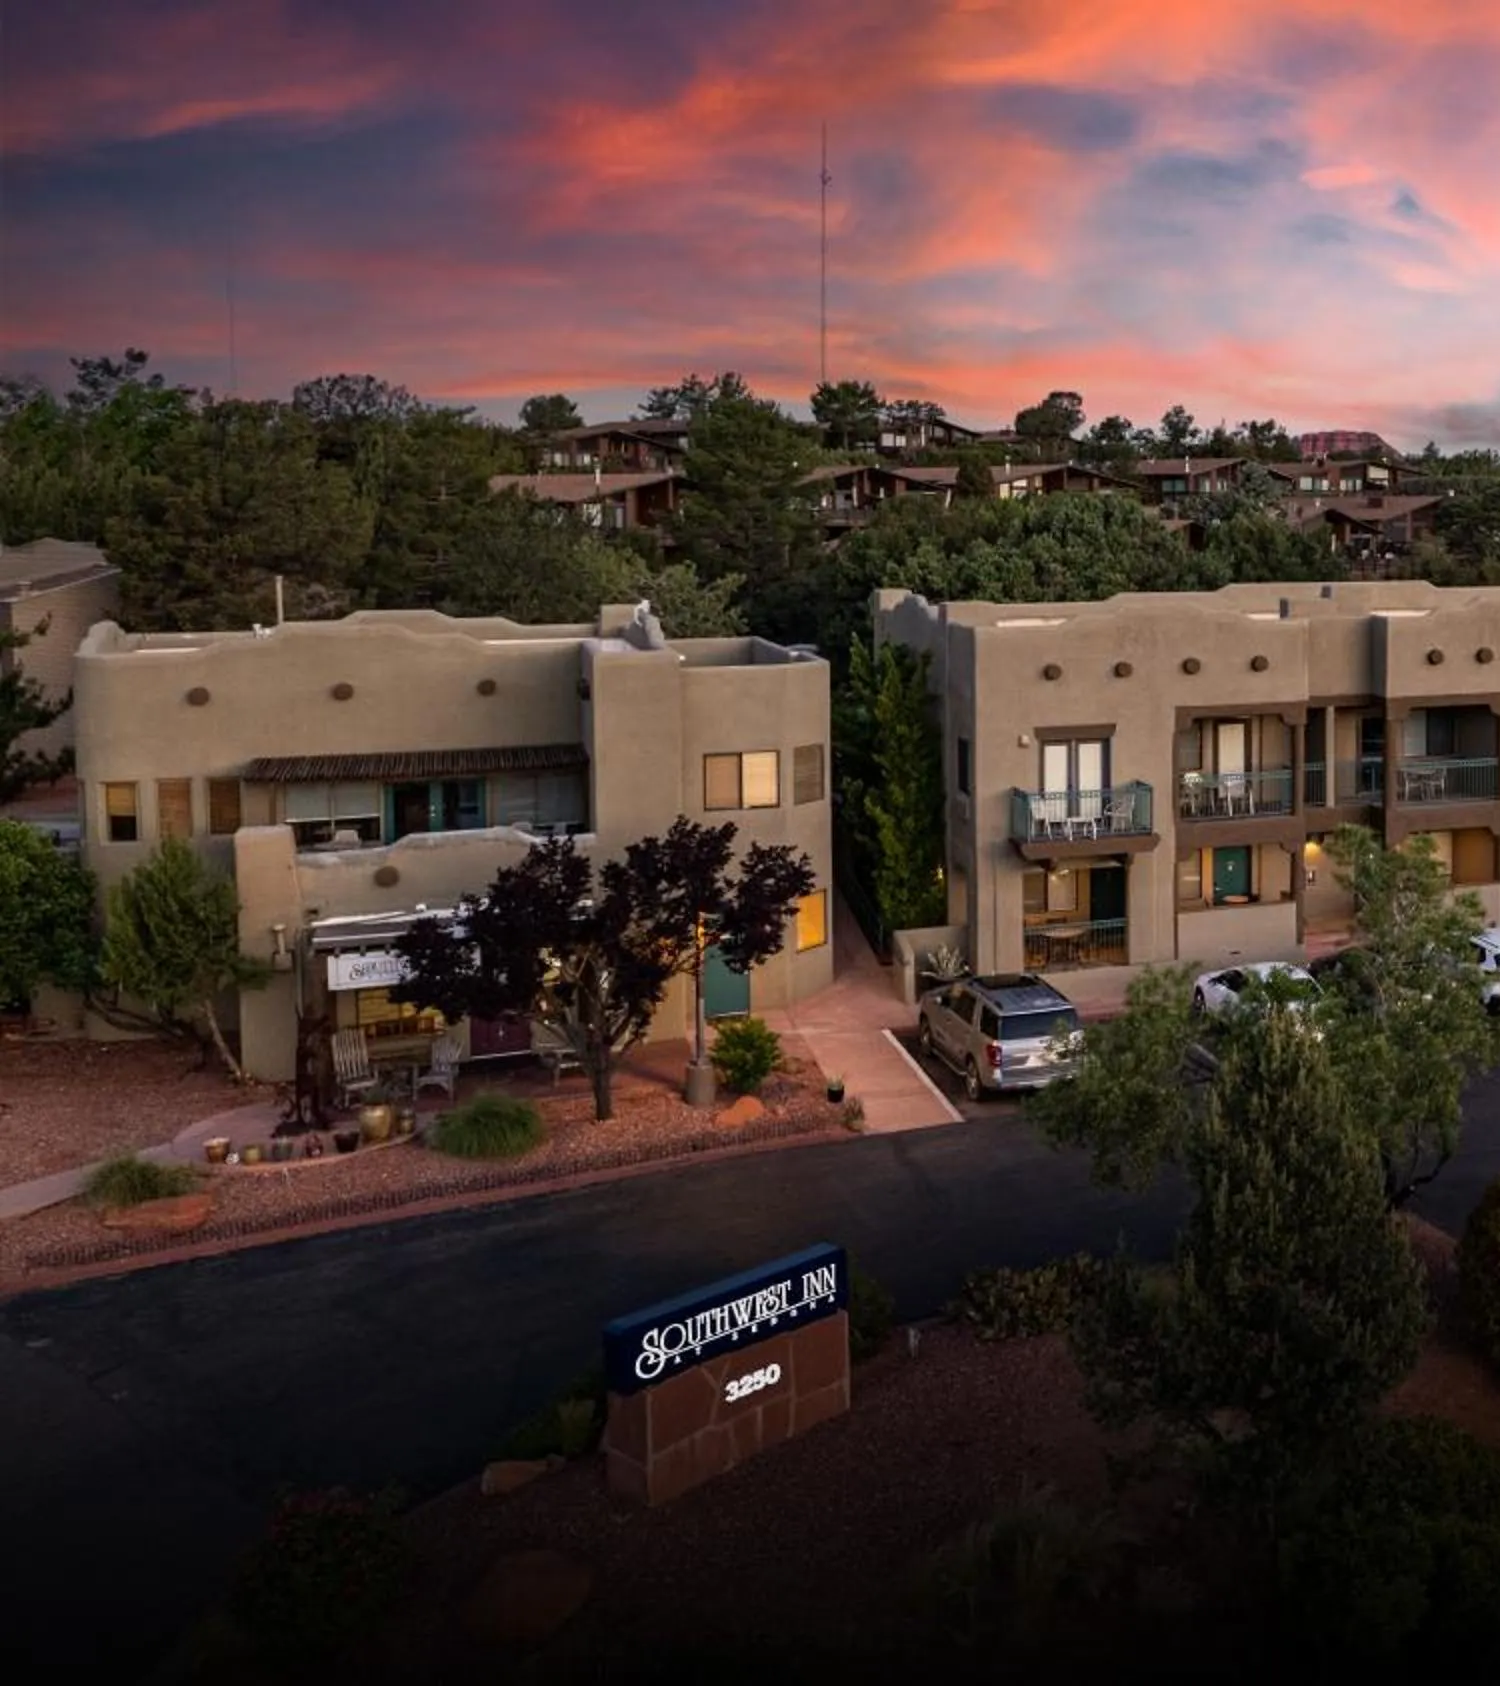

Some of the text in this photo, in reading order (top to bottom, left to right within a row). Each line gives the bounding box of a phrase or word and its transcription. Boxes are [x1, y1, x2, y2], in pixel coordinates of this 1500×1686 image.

[635, 1263, 837, 1379] SOUTHWEST INN
[725, 1363, 781, 1402] 3250
